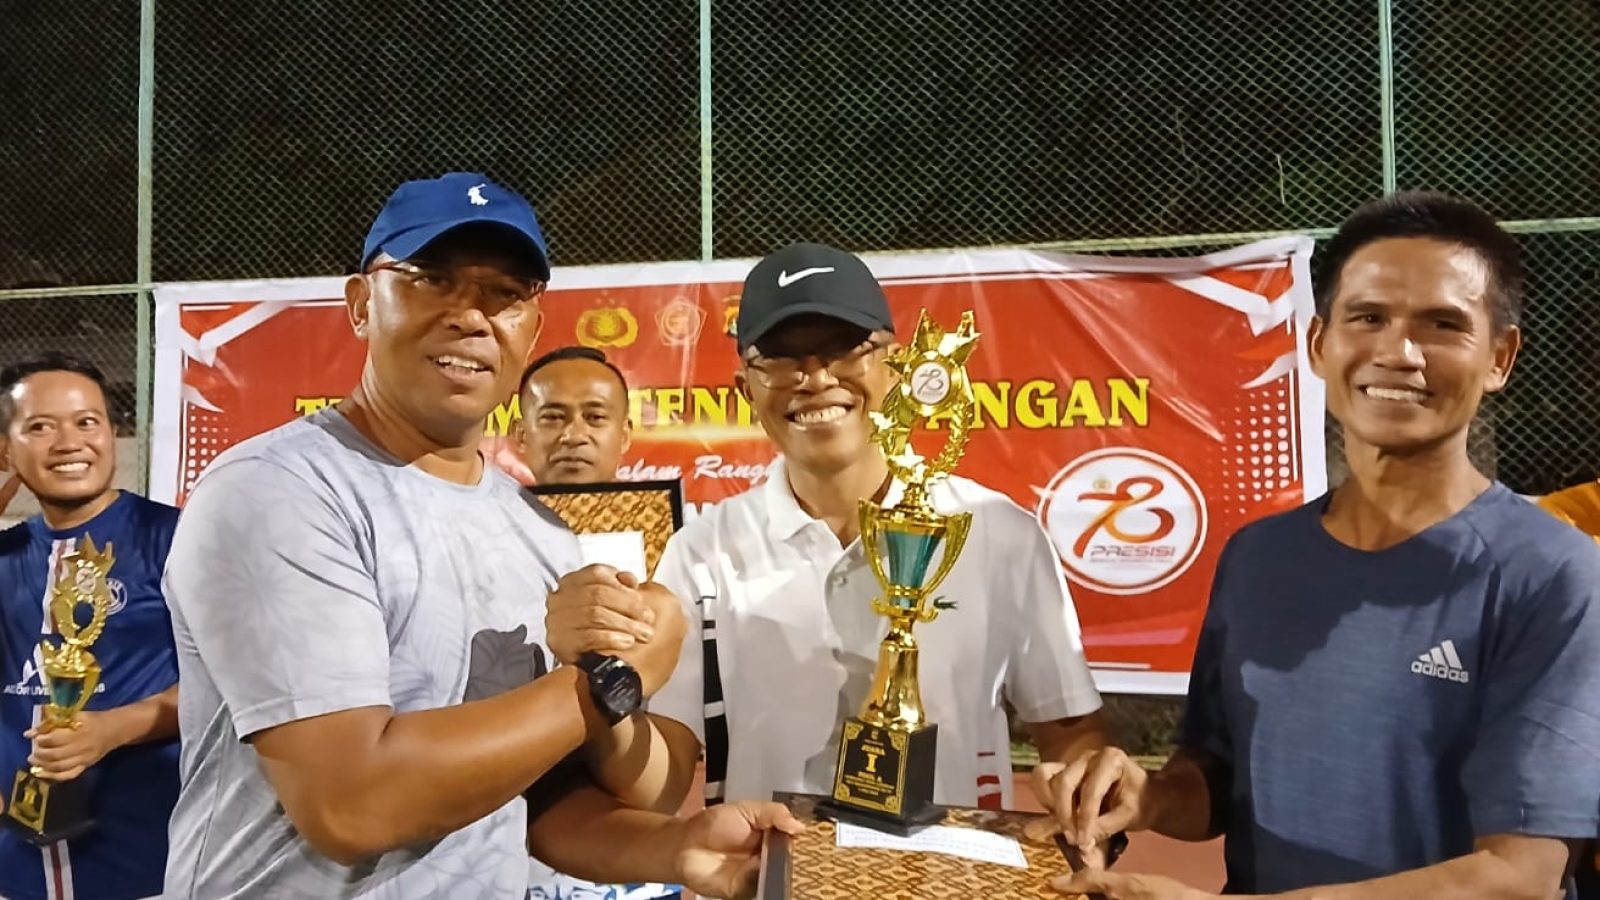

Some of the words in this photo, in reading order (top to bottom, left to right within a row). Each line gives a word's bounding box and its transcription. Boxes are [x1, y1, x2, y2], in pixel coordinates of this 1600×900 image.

[617, 458, 682, 481] alam
[1090, 545, 1176, 557] PRESISI
[1411, 661, 1469, 683] adidas
